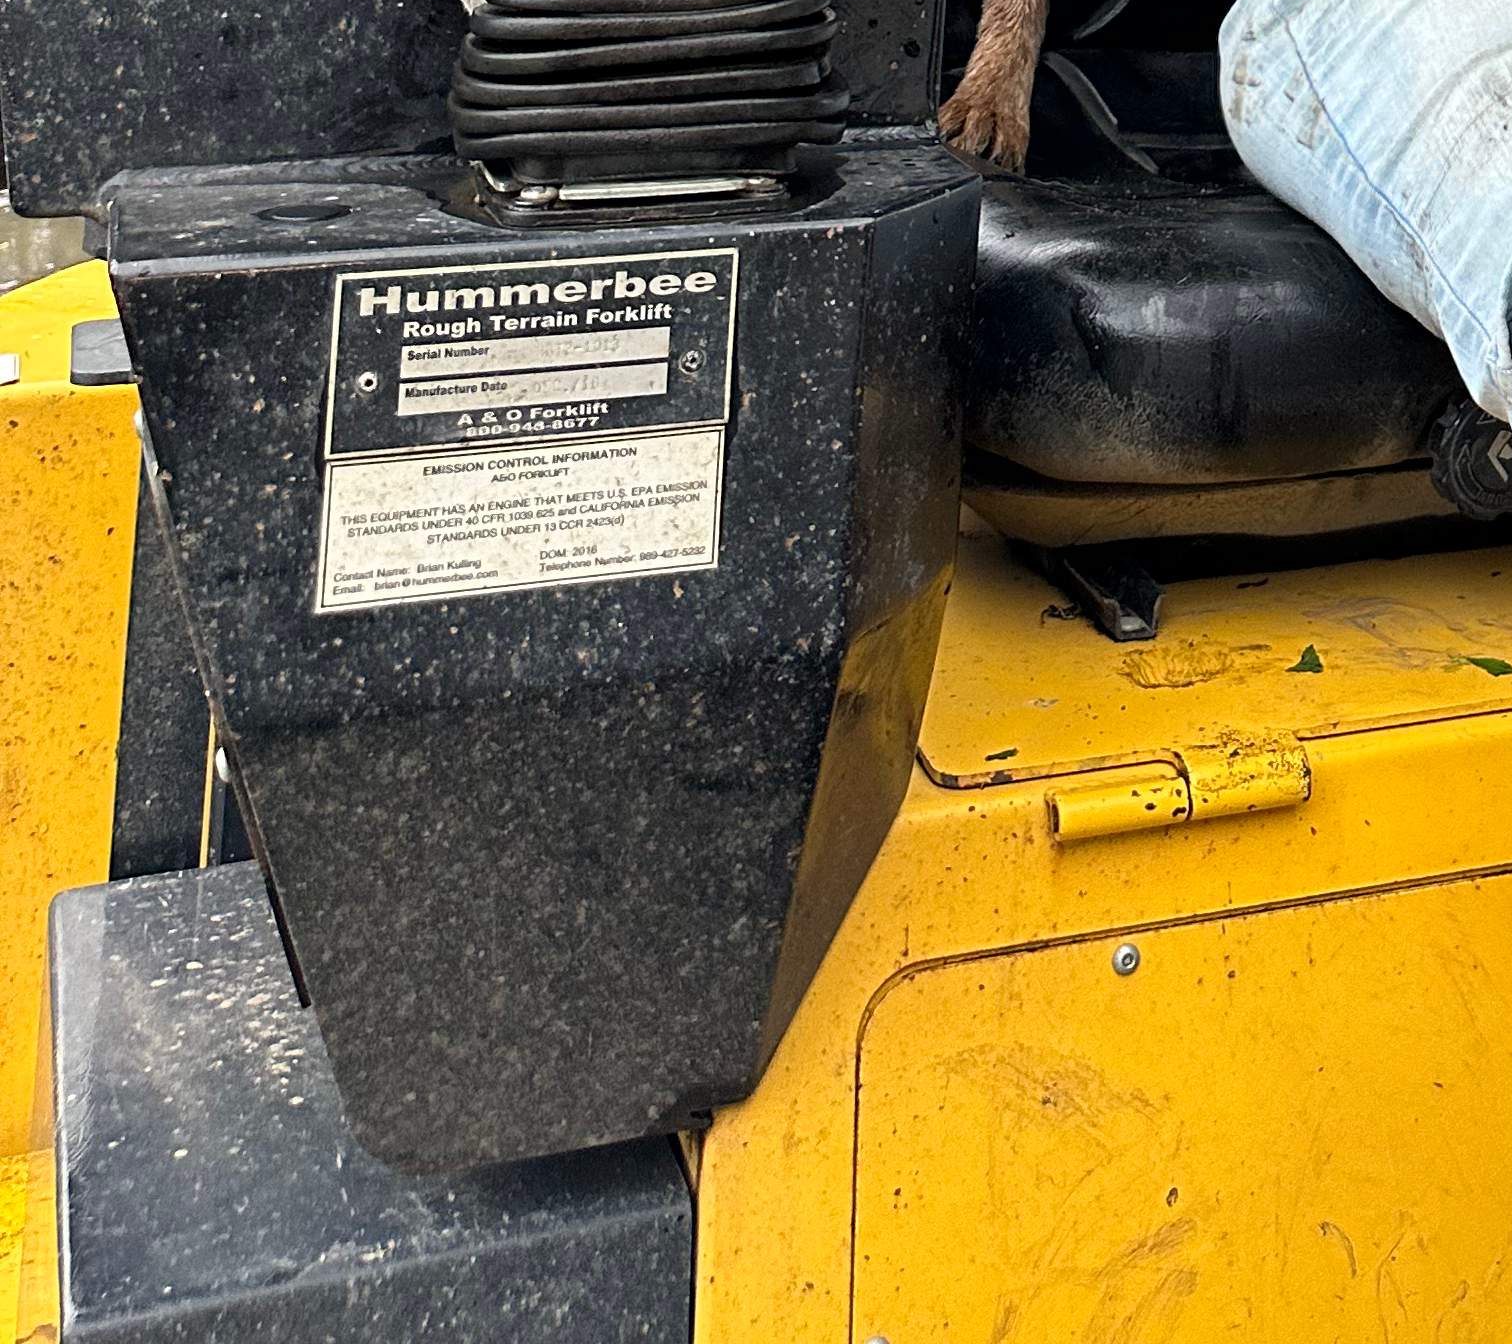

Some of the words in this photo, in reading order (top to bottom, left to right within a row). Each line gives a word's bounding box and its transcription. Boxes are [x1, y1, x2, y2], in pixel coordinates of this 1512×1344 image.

[359, 270, 717, 317] Hummerbee
[403, 317, 482, 339] Rough
[489, 310, 578, 332] Terrain
[586, 303, 673, 325] Forklift
[407, 348, 441, 361] Serial
[444, 345, 490, 358] Number
[405, 383, 478, 399] Manufacture
[481, 381, 508, 392] Date
[457, 413, 474, 426] A
[481, 411, 498, 423] &
[506, 409, 523, 421] O
[529, 402, 609, 419] Forklift
[423, 462, 484, 477] EMISSION
[487, 456, 549, 470] CONTROL
[552, 447, 637, 464] INFORMATION
[518, 467, 570, 480] FORKLIFT
[341, 514, 367, 525] THIS
[370, 507, 440, 524] EQUIPMENT
[442, 504, 466, 515] HAS
[469, 502, 485, 513] AN
[488, 498, 531, 512] ENGINE
[535, 494, 563, 506] THAT
[566, 490, 604, 503] MEETS
[607, 488, 627, 500] U.S.
[631, 486, 653, 497] EPA
[656, 480, 708, 494] EMISSION
[347, 522, 419, 538] STANDARDS
[422, 517, 463, 531] UNDER
[466, 515, 479, 525] 40
[482, 512, 505, 524] CFR
[558, 506, 577, 517] and
[579, 500, 645, 514] CALIFORNIA
[648, 493, 700, 507] EMISSION
[427, 528, 498, 544] STANDARDS
[501, 523, 541, 537] UNDER
[334, 570, 374, 583] Contact
[539, 559, 592, 573] Telephone
